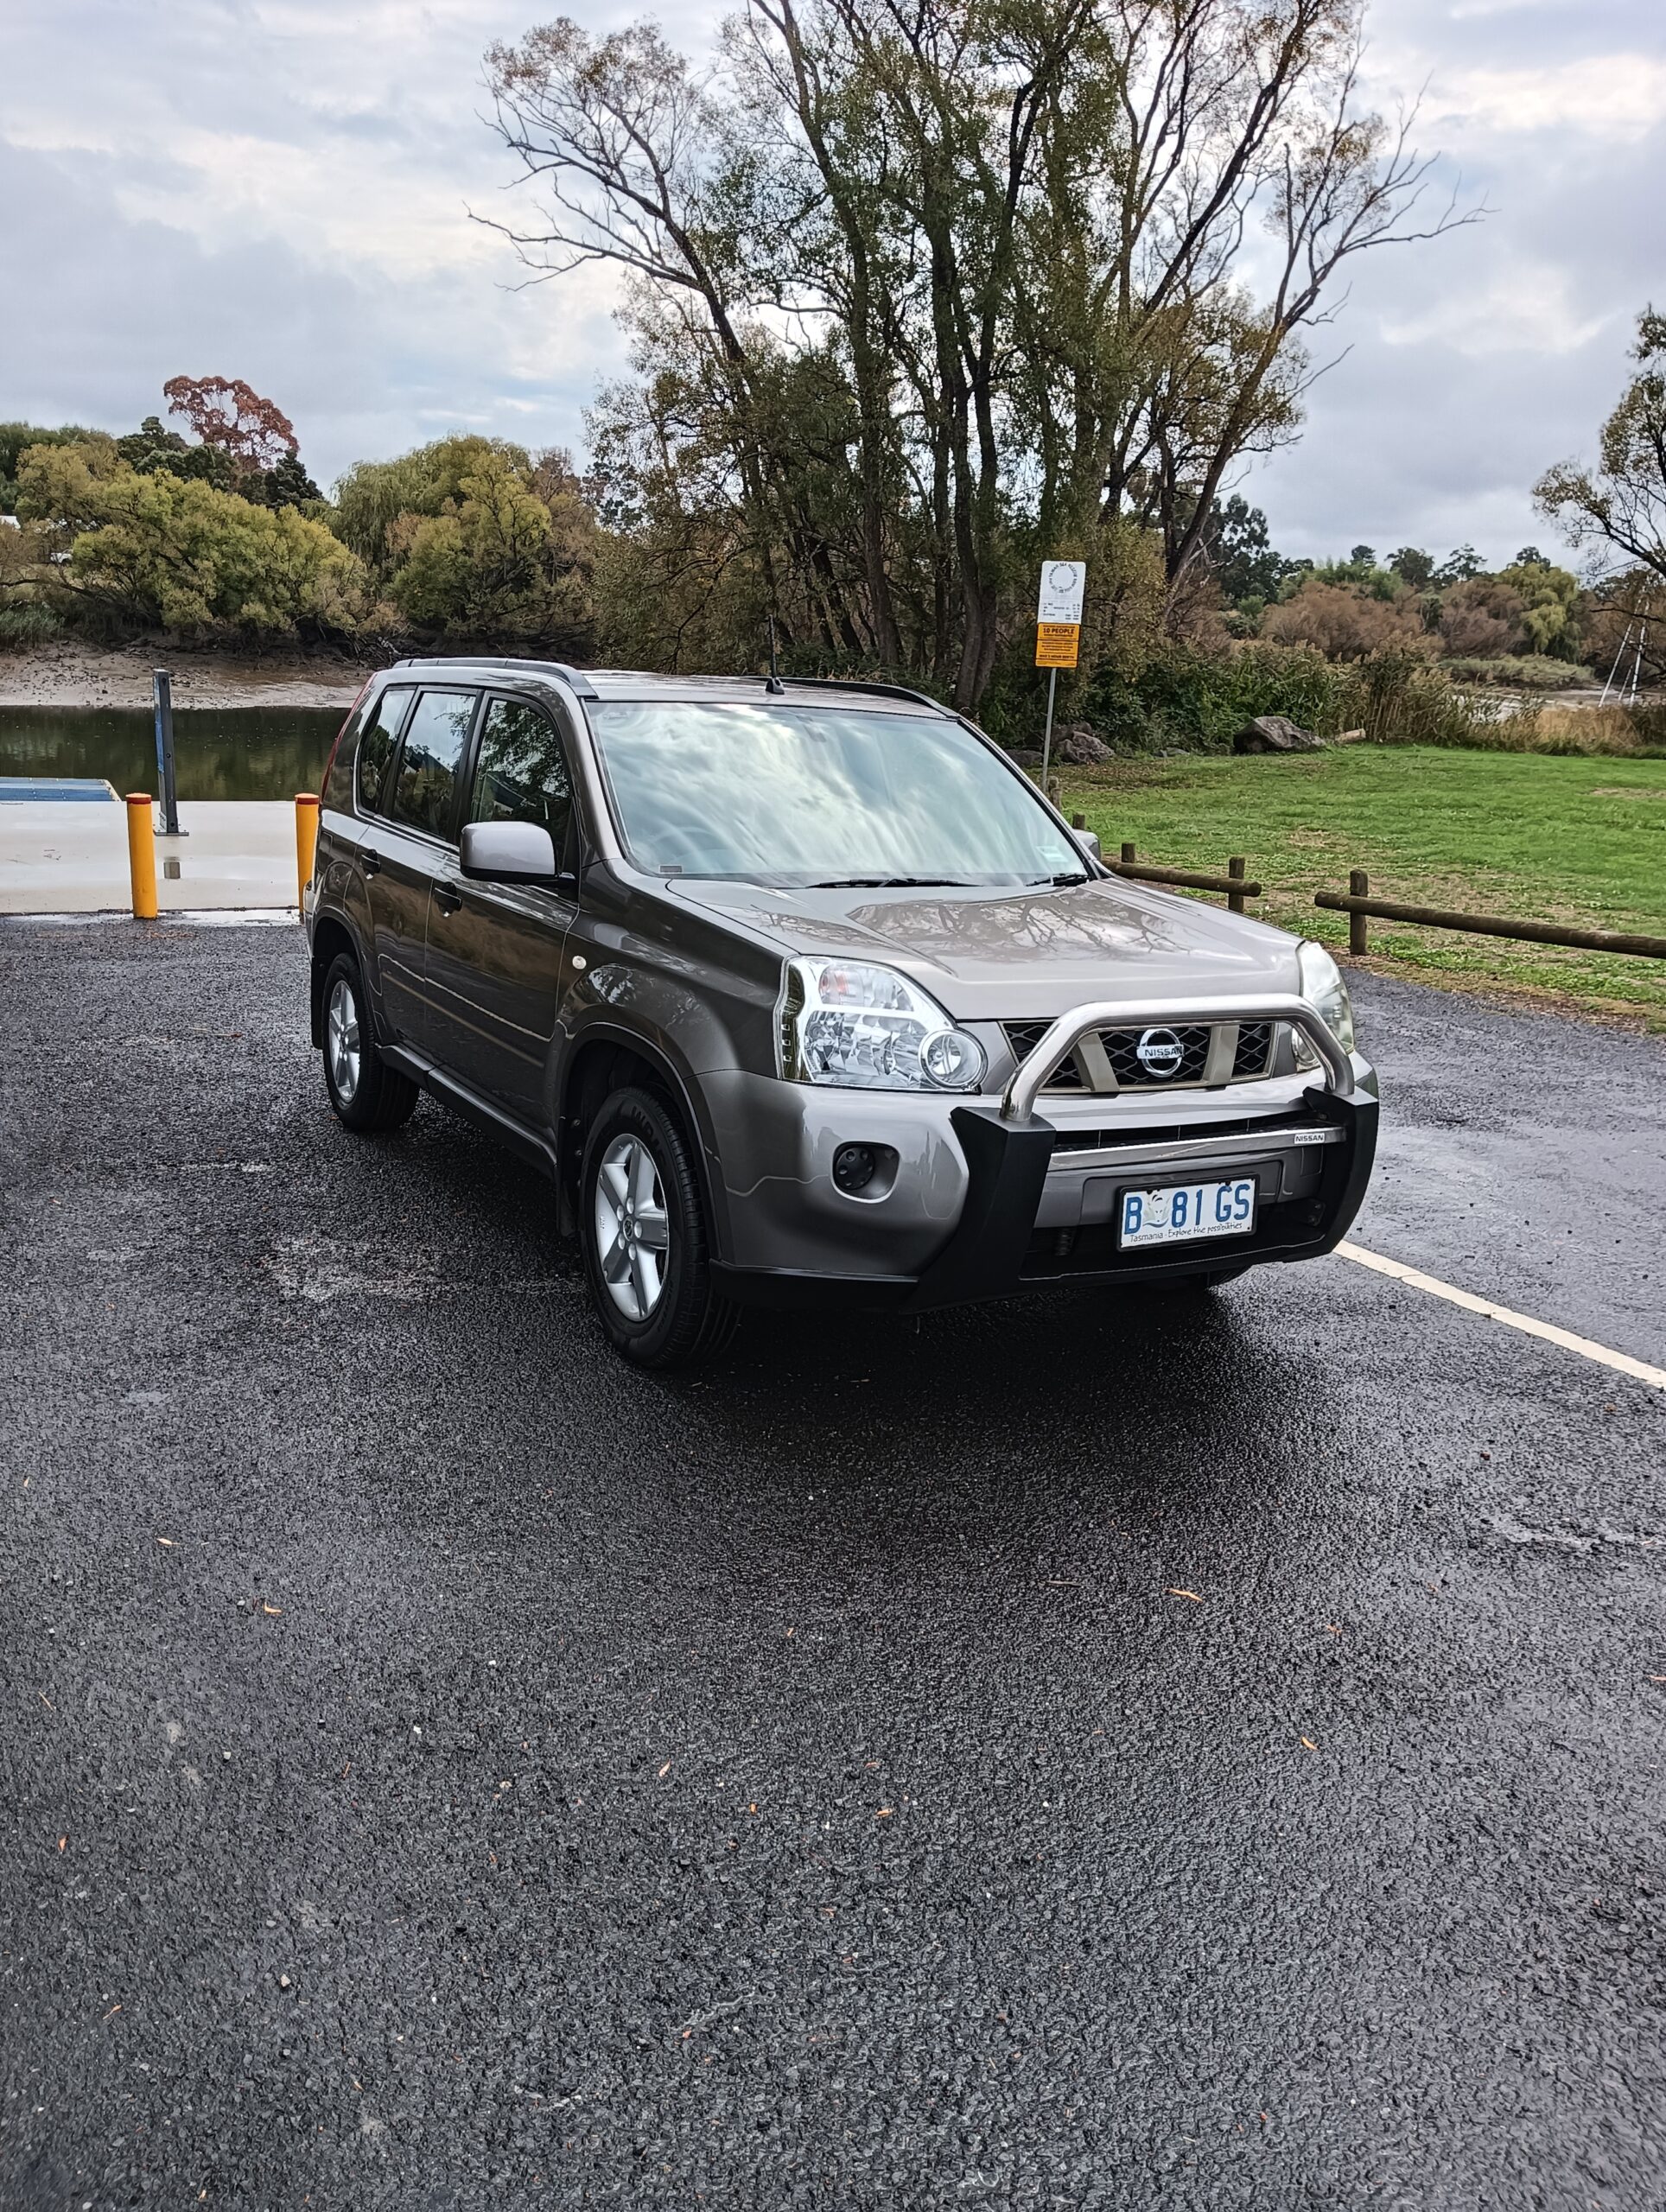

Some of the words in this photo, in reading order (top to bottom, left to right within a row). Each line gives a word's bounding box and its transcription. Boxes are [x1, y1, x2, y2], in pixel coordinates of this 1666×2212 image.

[1144, 1046, 1183, 1057] NISSAN
[1215, 1183, 1250, 1223] GS
[1129, 1231, 1164, 1243] Tasmania
[1168, 1228, 1192, 1238] Explore
[1193, 1225, 1206, 1234] the
[1207, 1222, 1243, 1236] possibilities
